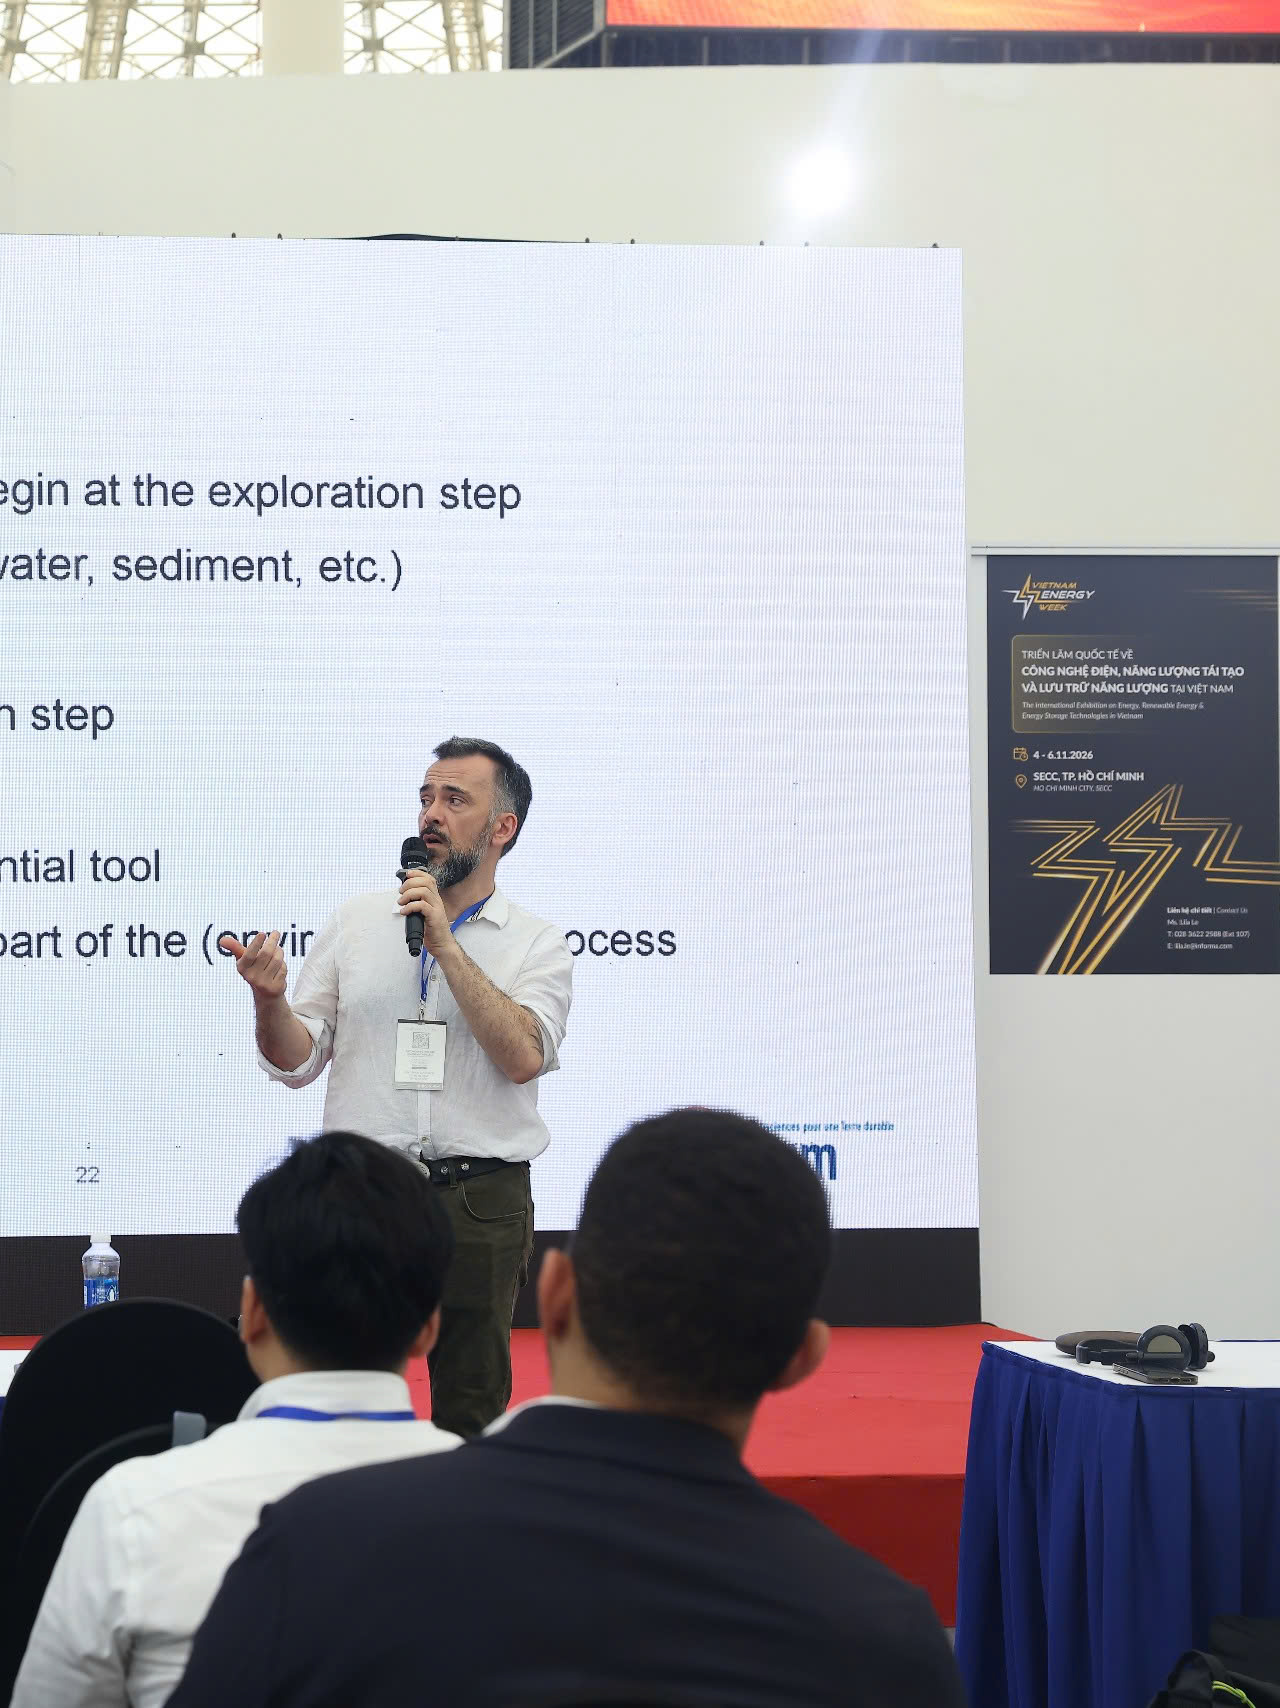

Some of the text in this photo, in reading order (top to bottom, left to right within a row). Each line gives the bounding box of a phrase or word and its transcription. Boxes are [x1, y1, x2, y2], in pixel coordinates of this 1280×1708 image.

[84, 475, 120, 506] at
[133, 473, 194, 507] the
[209, 474, 423, 516] exploration
[440, 478, 521, 519] step
[112, 548, 302, 588] sediment,
[319, 551, 403, 591] etc.)
[1041, 590, 1095, 599] ENERGY
[1021, 664, 1245, 679] CÔNG NGHỆ ĐIỆN, NĂNG LƯỢNG TÁI TẠO
[1021, 680, 1234, 695] VÀ LƯU TRỮ NĂNG LƯỢNG TẠI VIỆT NAM
[1176, 702, 1198, 710] Energy
[31, 699, 114, 740] step
[1022, 712, 1043, 720] Energy
[1044, 712, 1068, 720] Storage
[1069, 712, 1108, 720] Technologies
[1033, 751, 1094, 760] 4 6.11.2026
[1033, 769, 1144, 782] SECC, TP. HỒ CHÍ MINH
[90, 849, 160, 882] tool
[75, 923, 114, 958] of
[125, 923, 187, 958] the
[565, 930, 677, 956] ocess
[76, 1166, 100, 1183] 22
